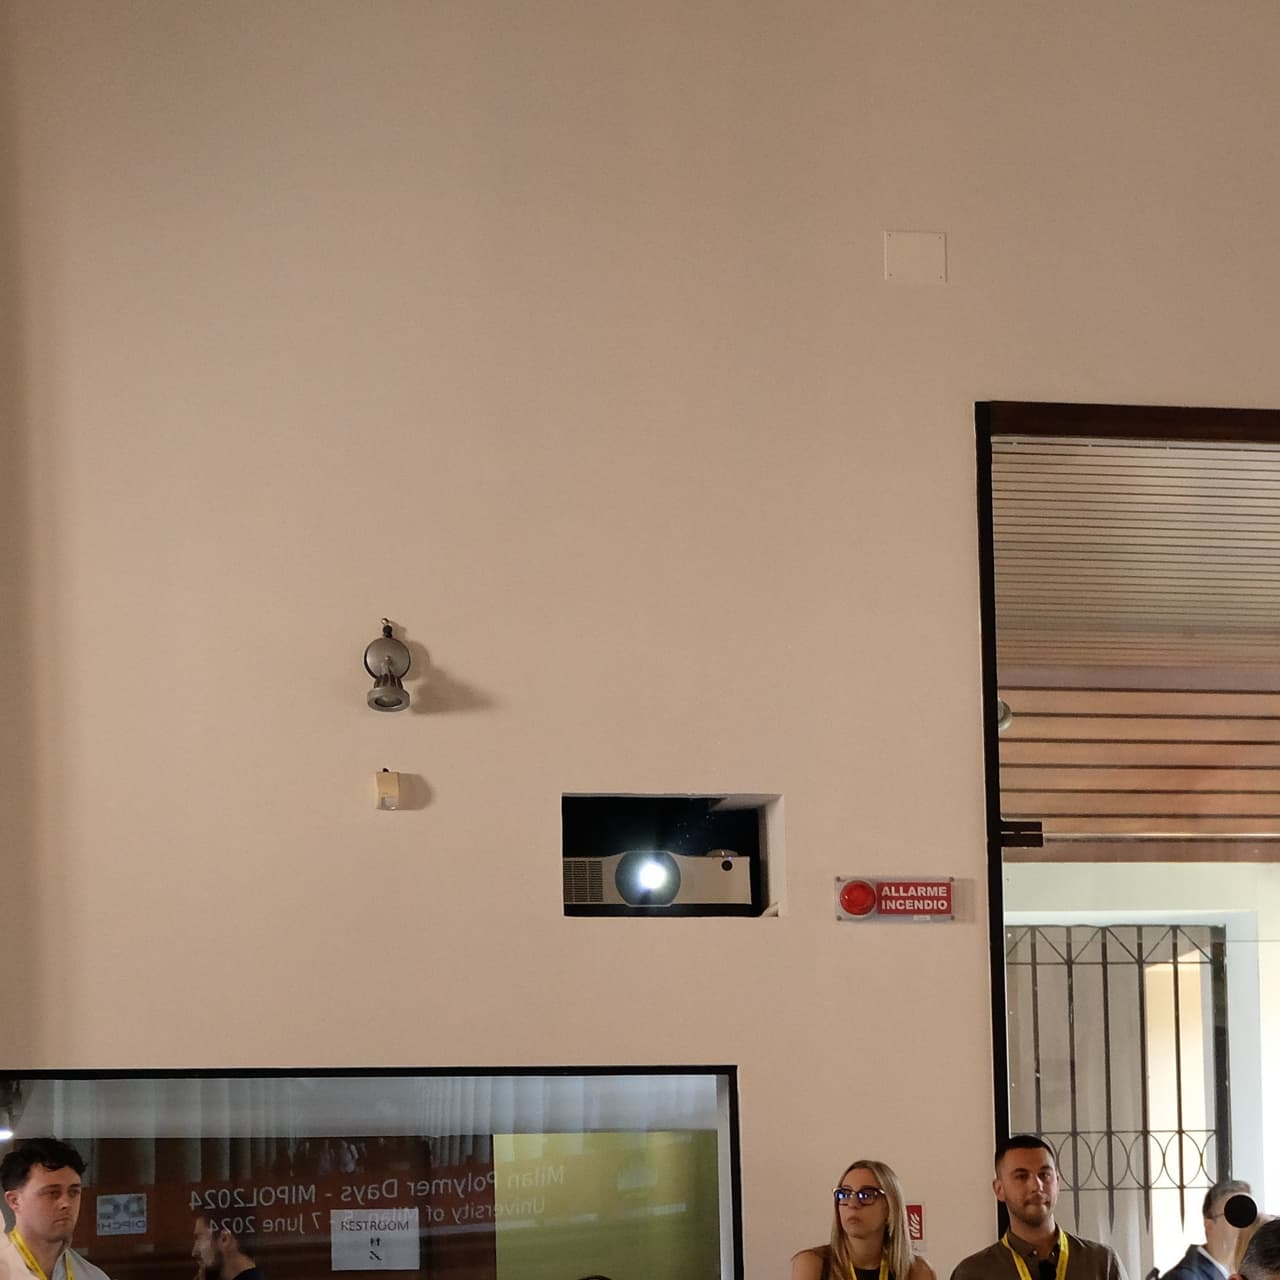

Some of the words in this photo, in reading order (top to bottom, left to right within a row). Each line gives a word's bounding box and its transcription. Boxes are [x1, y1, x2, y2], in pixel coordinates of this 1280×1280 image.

[881, 886, 947, 897] ALLARME
[881, 899, 948, 910] INCENDIO
[340, 1219, 410, 1232] RESTROOM
